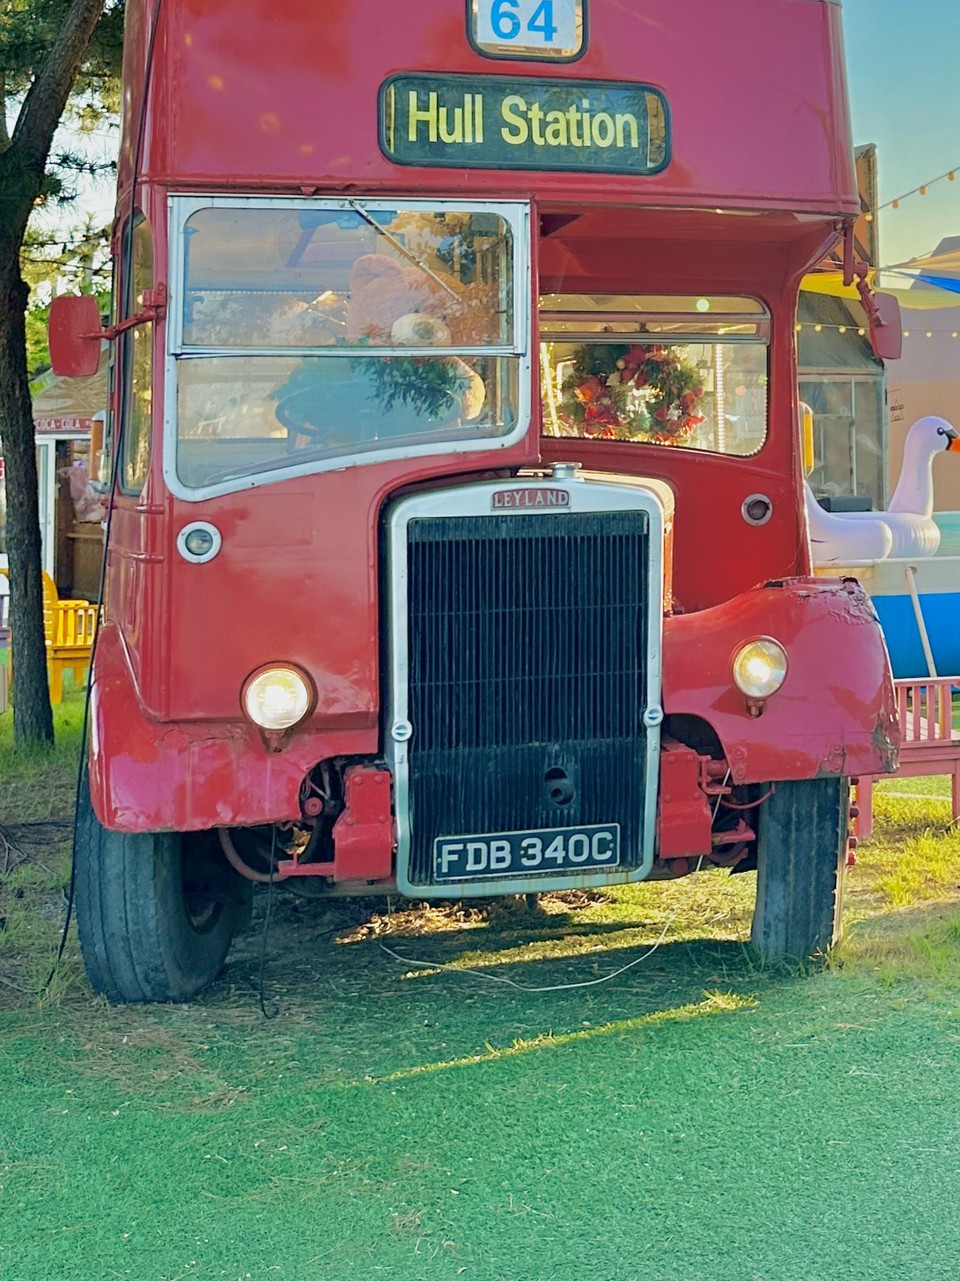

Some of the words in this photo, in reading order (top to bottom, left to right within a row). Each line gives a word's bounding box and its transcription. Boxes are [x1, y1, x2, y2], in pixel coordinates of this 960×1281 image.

[408, 90, 484, 144] Hull
[501, 94, 639, 149] Station
[494, 490, 569, 507] LEYLAND
[441, 840, 512, 873] FDB
[520, 831, 614, 867] 340C
